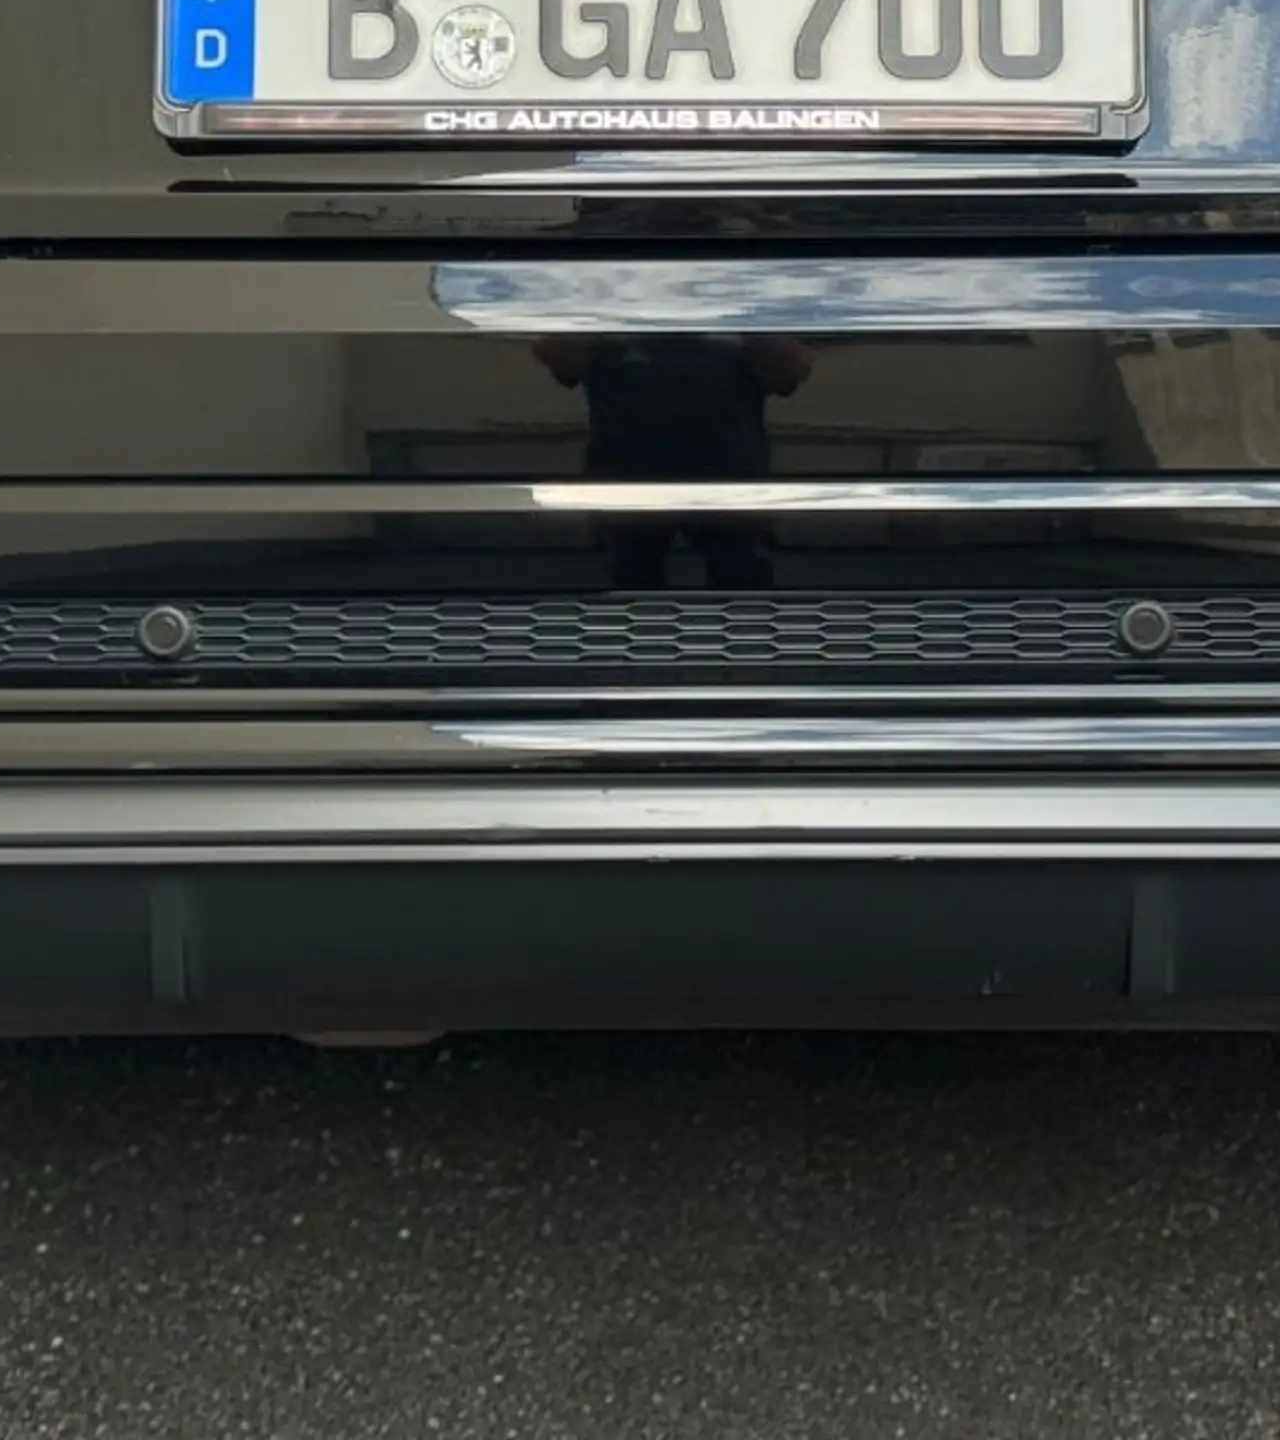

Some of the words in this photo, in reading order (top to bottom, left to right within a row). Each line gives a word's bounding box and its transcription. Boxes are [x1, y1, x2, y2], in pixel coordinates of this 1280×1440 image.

[195, 29, 228, 68] D
[423, 109, 497, 130] CHG
[507, 109, 699, 130] AUTOHAUS
[708, 109, 880, 130] BALINGEN
